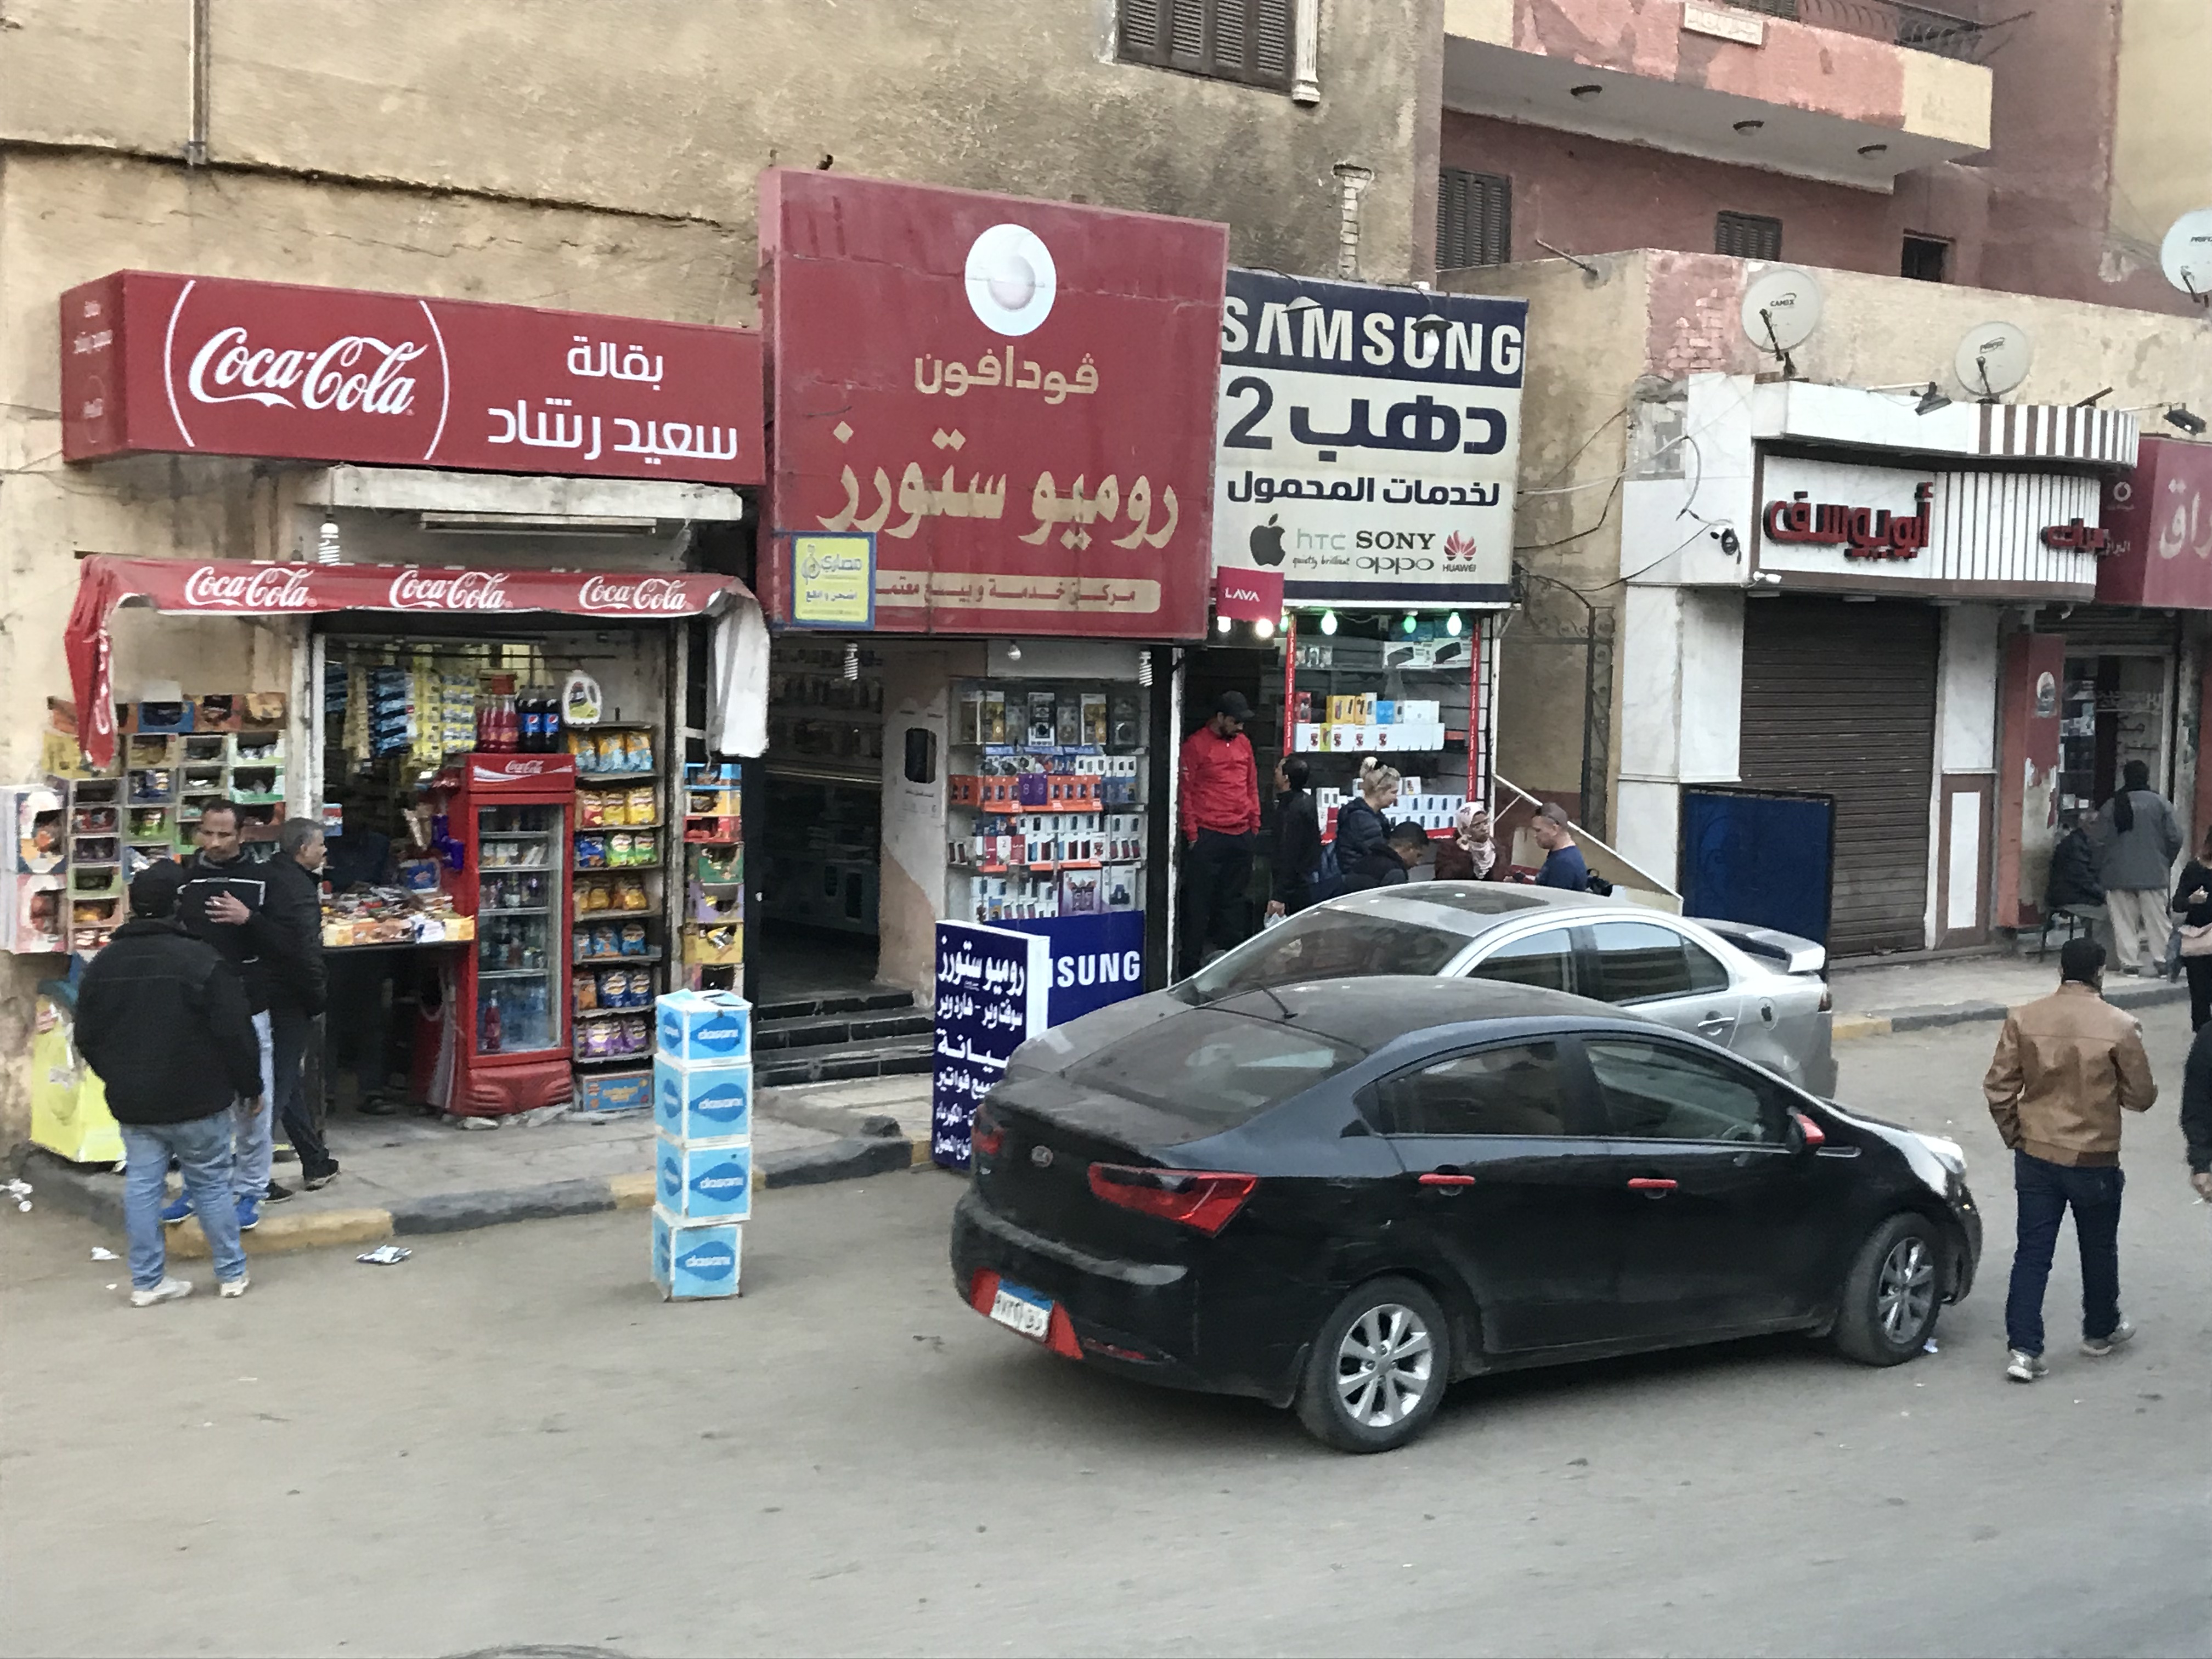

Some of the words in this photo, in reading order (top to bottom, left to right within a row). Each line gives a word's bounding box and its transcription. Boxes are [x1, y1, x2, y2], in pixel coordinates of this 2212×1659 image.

[1221, 296, 1522, 375] SAMSUNG
[188, 326, 429, 415] Coca-Cola
[567, 335, 664, 391] بقالة
[488, 397, 602, 460] رشاد
[1223, 375, 1274, 450] 2
[1289, 394, 1508, 462] دهب
[613, 417, 738, 465] سعيد
[816, 420, 1007, 540] ستورز
[1227, 470, 1375, 504] المحمول
[1382, 477, 1500, 507] لخدمات
[1018, 470, 1178, 550] روميو
[1356, 530, 1436, 550] SONY
[876, 575, 919, 595] معتم
[1356, 556, 1435, 575] oppo
[1442, 564, 1477, 572] HUAWEI
[184, 566, 314, 608] Coca-Cola
[389, 569, 510, 609] Coca-Cola
[579, 575, 687, 611] Coca-Cola
[989, 578, 1065, 600] خدمة
[1224, 586, 1261, 602] LAVA
[938, 935, 983, 985] ستورز
[982, 956, 1025, 997] روميو
[1047, 950, 1141, 988] SUNG
[935, 1028, 1010, 1074] يانة
